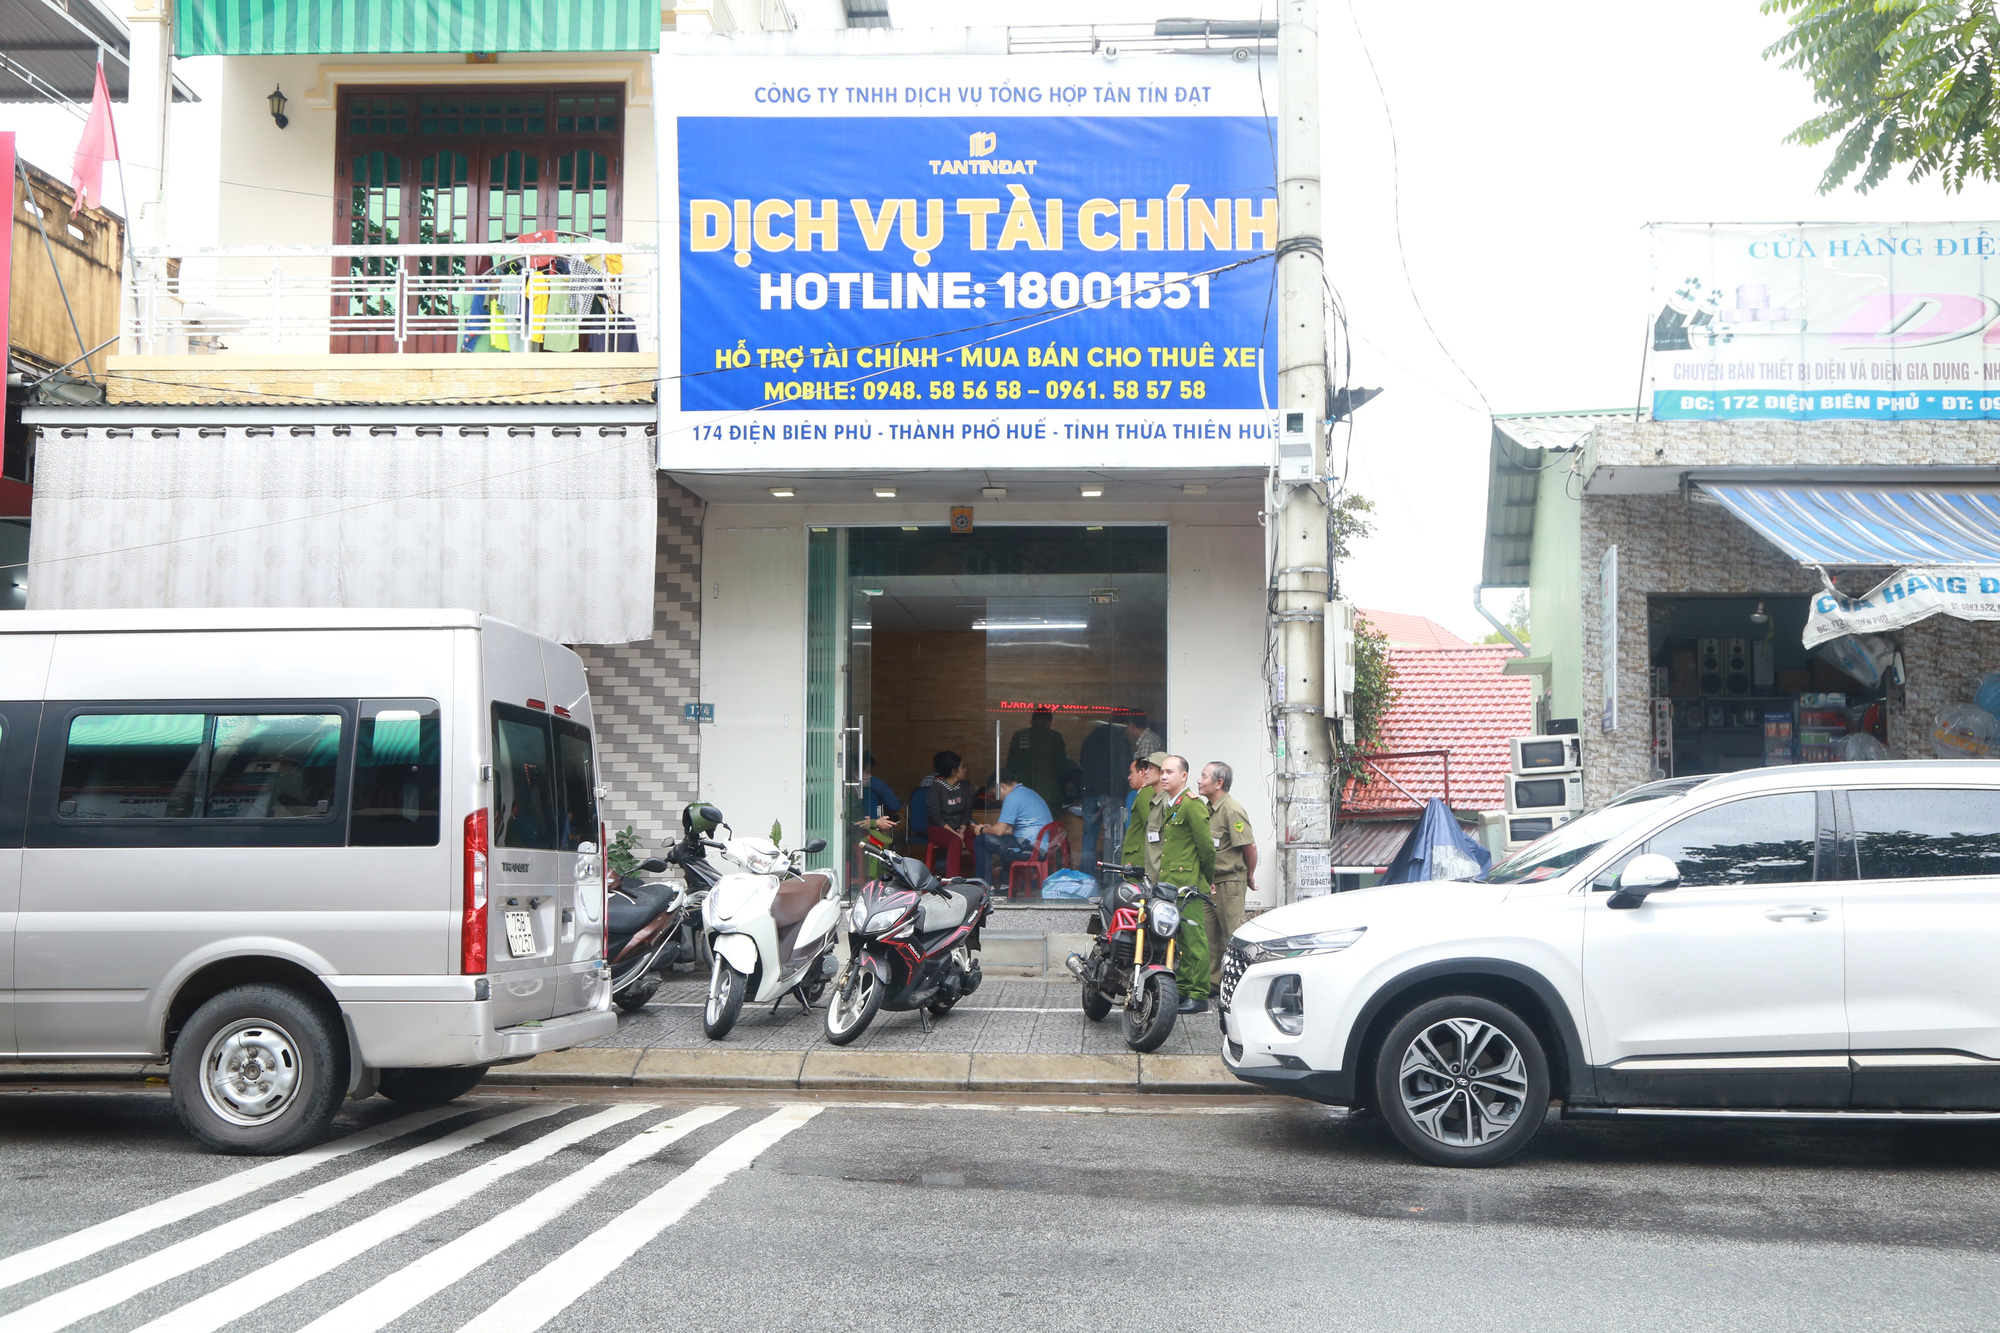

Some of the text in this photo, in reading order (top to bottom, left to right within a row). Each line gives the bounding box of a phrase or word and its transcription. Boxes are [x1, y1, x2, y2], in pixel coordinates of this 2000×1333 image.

[754, 79, 1212, 107] CÔNG TY TNHH DỊCH VỤ TỔNG HỢP TÂN TÍN ĐẠT
[689, 184, 1279, 268] DỊCH VỤ TÀI CHÍNH
[1748, 230, 2000, 261] CỬA HÀNG ĐIỆ
[760, 272, 1210, 310] HOTLINE: 18001551
[715, 339, 751, 369] HỖ
[756, 345, 805, 373] TRỢ
[810, 342, 849, 369] TÀI
[856, 341, 938, 368] CHÍNH
[961, 347, 1020, 368] MUA
[1028, 342, 1079, 367] BÁN
[1087, 347, 1142, 368] CHO
[1147, 342, 1215, 368] THUÊ
[1223, 347, 1256, 367] XE
[1673, 359, 1724, 381] CHUYÊN
[1728, 359, 1755, 380] BÁN
[1758, 357, 1794, 380] THIẾT
[1798, 363, 1811, 385] BỊ
[1815, 359, 1846, 384] ĐIỆN
[1850, 358, 1867, 380] VÀ
[1871, 359, 1902, 385] ĐIỆN
[1906, 363, 1929, 381] GIA
[1933, 363, 1970, 384] DỤNG
[764, 381, 856, 400] MOBILE:
[863, 381, 922, 400] 0948.
[929, 381, 955, 399] 58
[962, 381, 988, 399] 56
[995, 380, 1022, 399] 58
[1046, 380, 1106, 399] 0961.
[1112, 380, 1139, 399] 58
[1146, 380, 1173, 399] 57
[1179, 380, 1206, 399] 58
[1680, 396, 1714, 411] ĐC:
[1722, 395, 1759, 410] 172
[1764, 394, 1814, 413] ĐIỆN
[1820, 393, 1870, 410] BIÊN
[1876, 392, 1919, 411] PHỦ
[1942, 396, 1973, 411] ĐT:
[693, 425, 722, 441] 174
[729, 420, 776, 444] ĐIỆN
[783, 420, 827, 440] BIÊN
[834, 419, 872, 440] PHỦ
[889, 419, 955, 440] THÀNH
[962, 418, 1000, 440] PHỐ
[1006, 417, 1046, 440] HUẾ
[1064, 418, 1109, 439] TỈNH
[1117, 419, 1167, 439] THỪA
[1173, 419, 1232, 439] THIÊN
